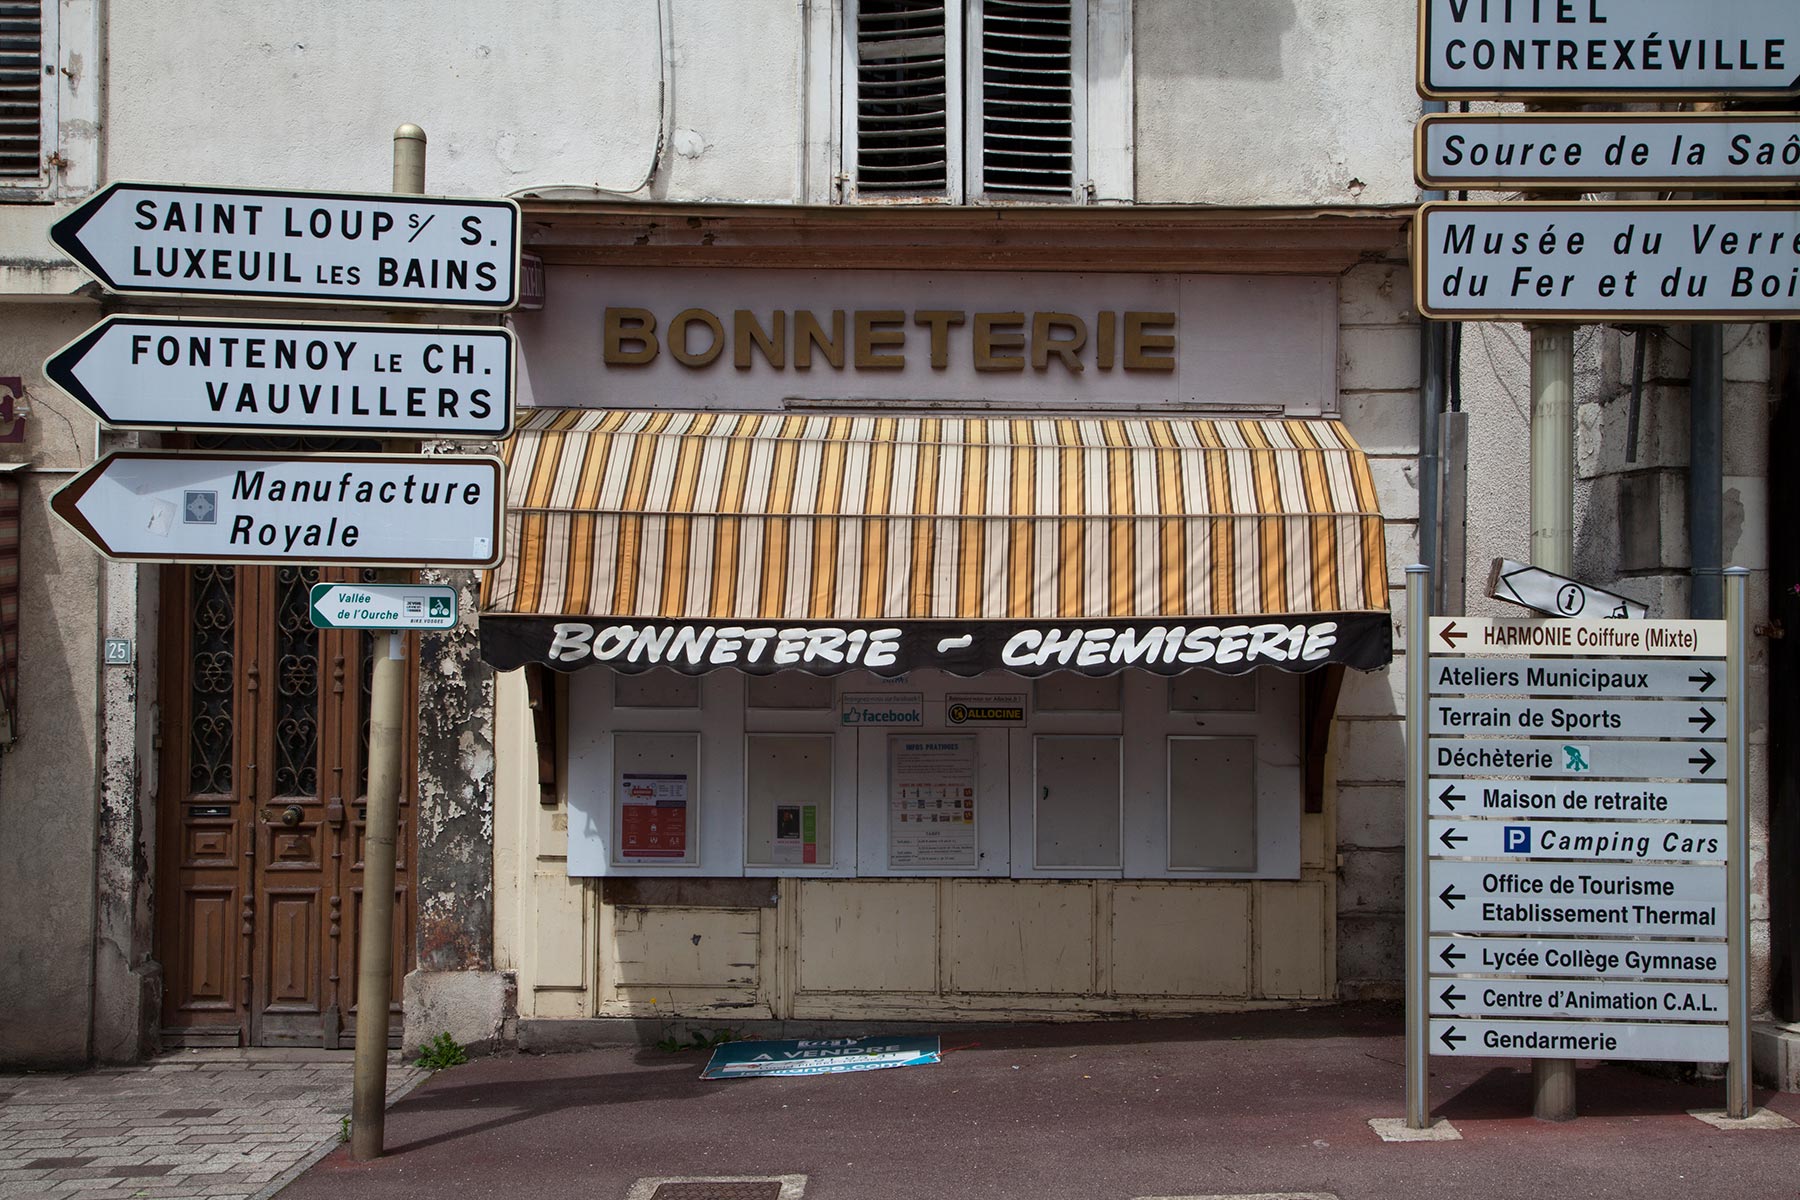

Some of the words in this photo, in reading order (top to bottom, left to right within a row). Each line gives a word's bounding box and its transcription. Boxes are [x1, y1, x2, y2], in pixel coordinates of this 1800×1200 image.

[1449, 0, 1607, 23] VITTEL
[1446, 32, 1784, 70] CONTREXÉVILLE
[1443, 135, 1581, 165] Source
[1605, 135, 1648, 165] de
[1672, 135, 1705, 165] la
[135, 200, 263, 235] SAINT
[285, 207, 393, 240] LOUP
[461, 216, 496, 246] S.
[1443, 224, 1584, 254] Musée
[1614, 224, 1662, 254] du
[133, 246, 302, 283] LUXEUIL
[317, 265, 360, 285] LES
[379, 257, 496, 291] BAINS
[1443, 267, 1488, 296] du
[1511, 267, 1574, 297] Fer
[1599, 271, 1637, 297] et
[1661, 267, 1707, 297] du
[604, 307, 1176, 372] BONNETERIE
[132, 335, 357, 371] FONTENOY
[375, 354, 401, 372] LE
[423, 344, 490, 374] CH.
[206, 382, 491, 419] VAUVILLERS
[232, 470, 480, 504] Manufacture
[230, 515, 359, 552] Royale
[338, 593, 371, 603] Vallée
[337, 609, 350, 619] de
[109, 642, 126, 659] 25
[547, 622, 901, 666] BONNETERIE
[1000, 622, 1339, 666] CHEMISERIE
[1485, 626, 1571, 645] HARMONIE
[1577, 627, 1639, 647] Coiffure
[1646, 628, 1697, 652] (Mixte)
[1439, 667, 1519, 686] Ateliers
[1527, 668, 1648, 691] Municipaux
[863, 709, 920, 722] facebook
[968, 709, 1021, 719] ALLOCINE
[1439, 707, 1510, 726] Terrain
[1519, 708, 1543, 727] de
[1551, 709, 1621, 731] Sports
[1438, 748, 1552, 768] Déchèterie
[1484, 789, 1555, 808] Maison
[1563, 791, 1587, 809] de
[1595, 792, 1667, 811] retraite
[1540, 830, 1650, 856] Camping
[1663, 832, 1718, 853] Cars
[1483, 874, 1543, 893] Office
[1550, 875, 1574, 894] de
[1579, 876, 1674, 895] Tourisme
[1483, 903, 1628, 923] Etablissement
[1632, 906, 1715, 925] Thermal
[1483, 948, 1538, 970] Lycée
[1545, 949, 1619, 972] Collège
[1625, 951, 1716, 973] Gymnase
[1484, 989, 1542, 1007] Centre
[1664, 993, 1717, 1011] C.A.L.
[1484, 1030, 1616, 1050] Gendarmerie
[751, 1053, 773, 1061] A
[783, 1044, 900, 1059] VENDRE
